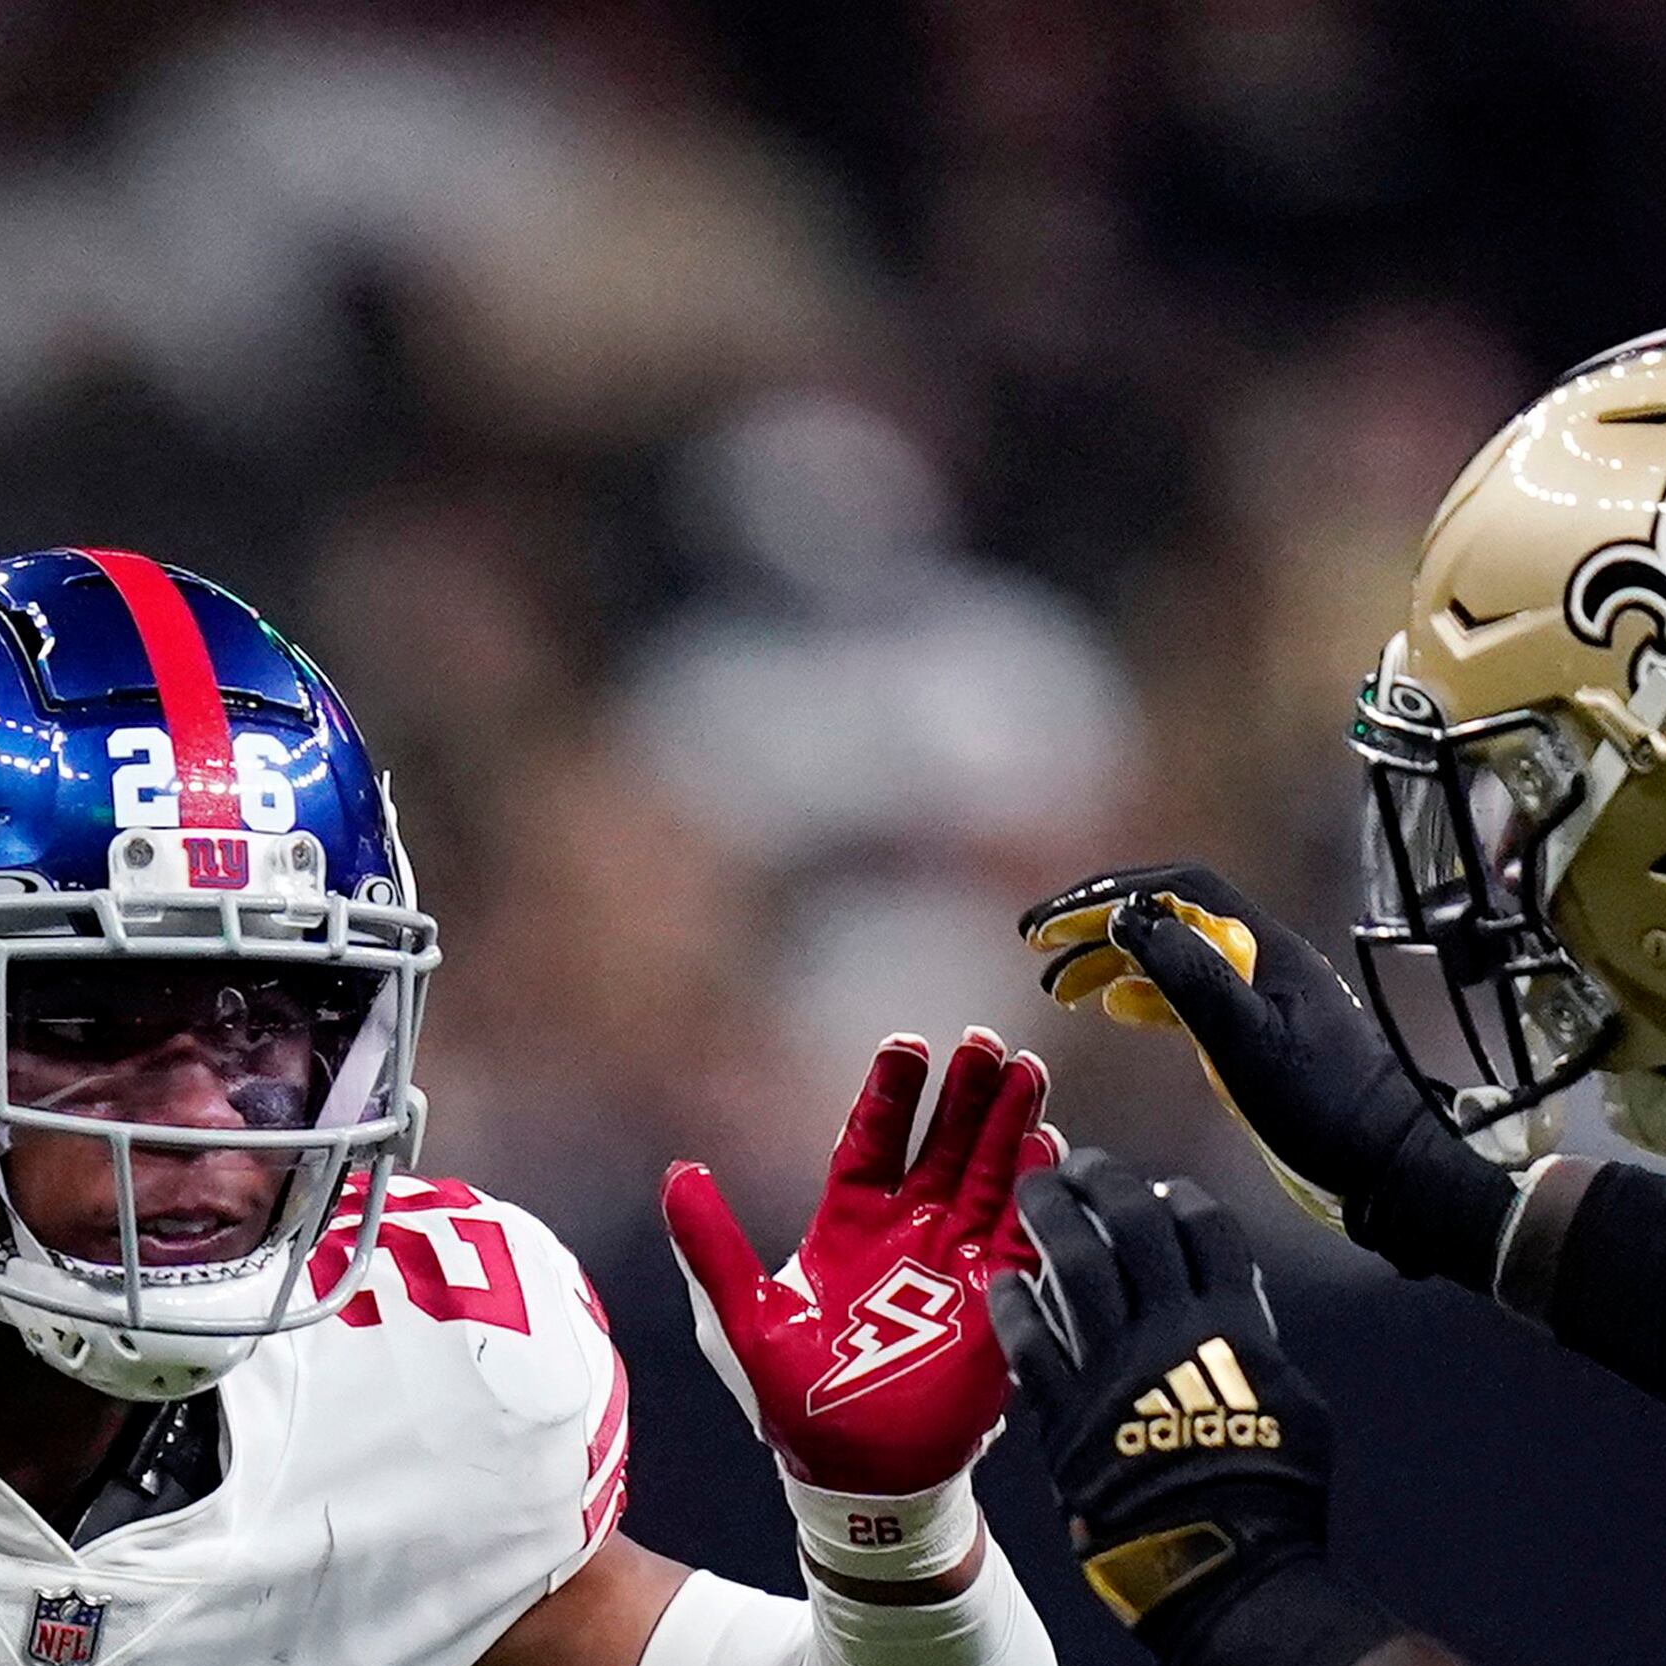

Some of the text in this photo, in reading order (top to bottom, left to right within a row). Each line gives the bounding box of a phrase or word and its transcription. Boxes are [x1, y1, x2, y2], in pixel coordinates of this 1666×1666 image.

[106, 727, 297, 834] 26
[1116, 1405, 1281, 1457] adidas
[848, 1513, 903, 1545] 26
[34, 1622, 90, 1663] NFL
